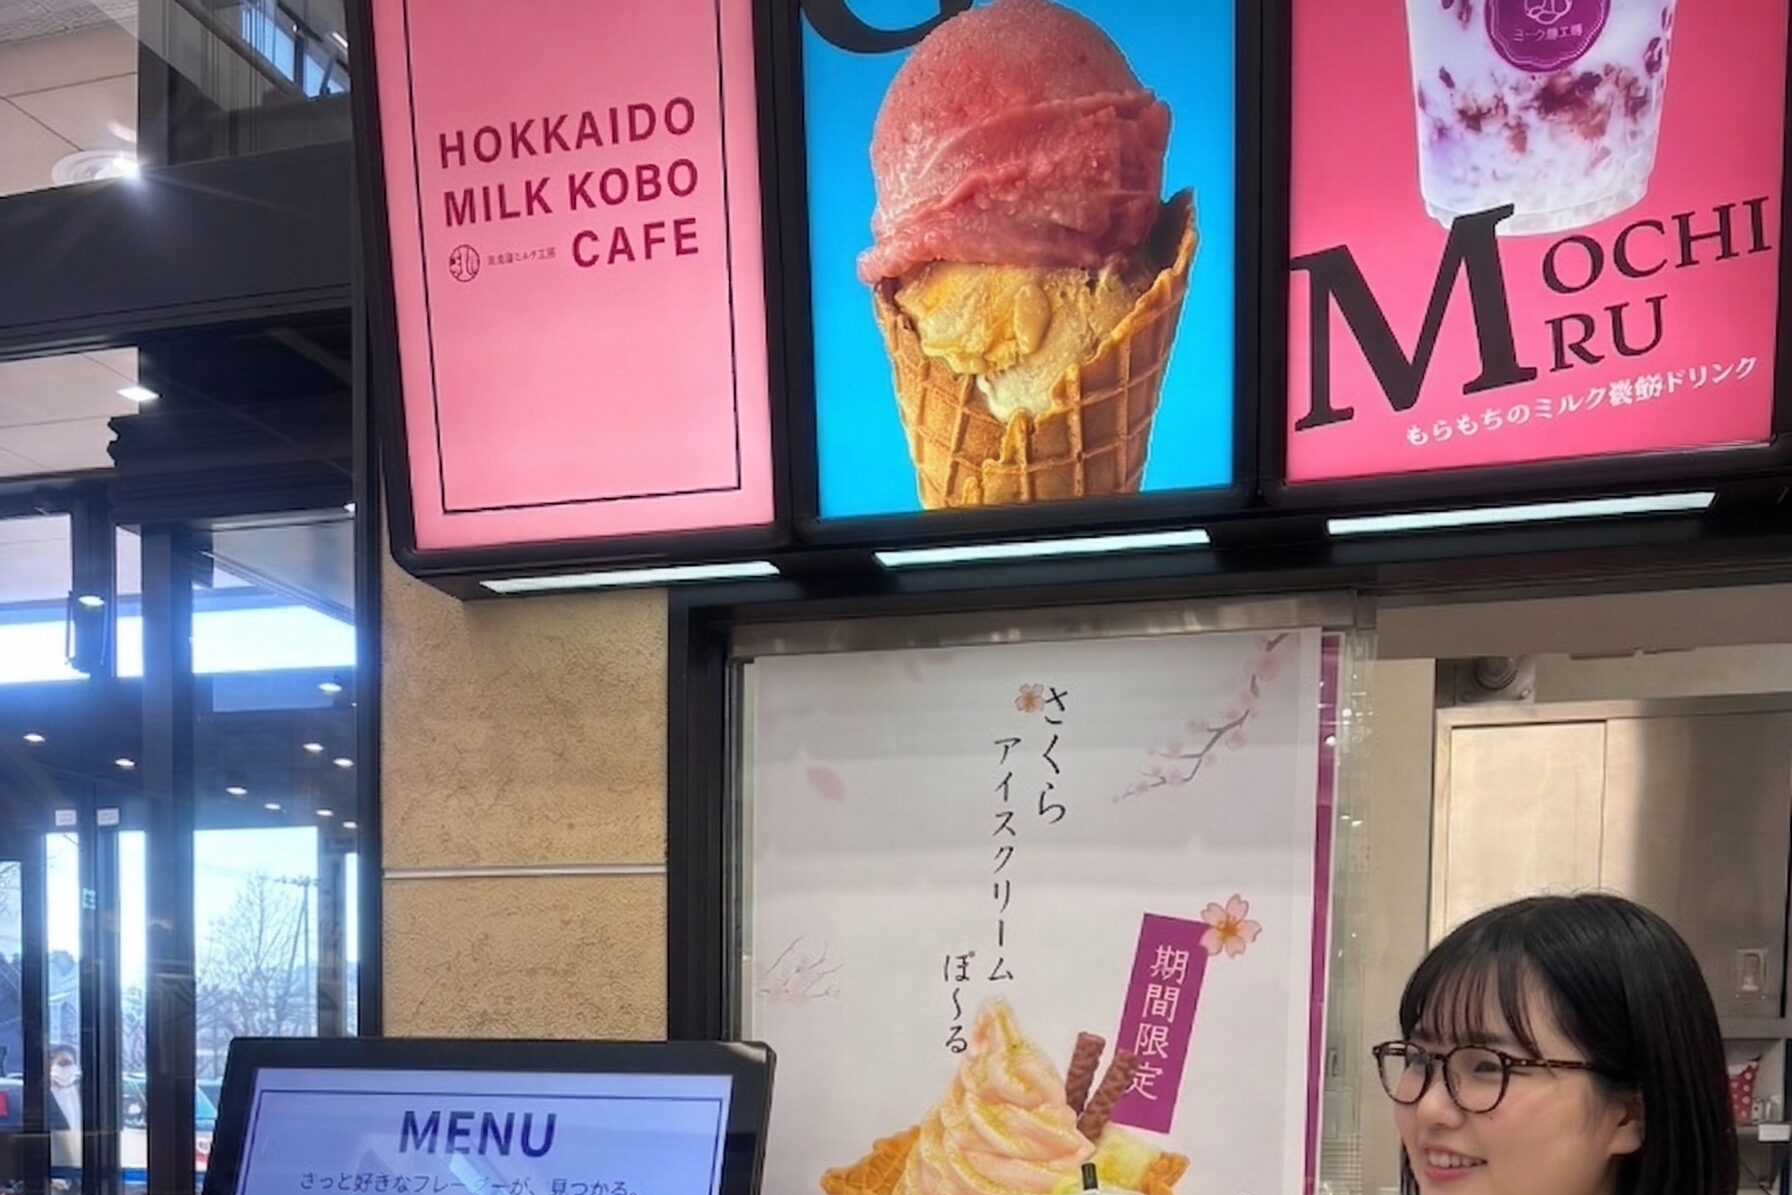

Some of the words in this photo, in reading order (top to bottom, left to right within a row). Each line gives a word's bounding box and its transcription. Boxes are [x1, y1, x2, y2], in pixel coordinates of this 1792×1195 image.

[438, 97, 696, 169] HOKKAIDO
[444, 177, 553, 227] MILK
[567, 158, 699, 212] KOBO
[572, 217, 699, 268] CAFE
[1545, 295, 1669, 373] RU
[1038, 686, 1068, 824] さくら
[988, 736, 1022, 981] アイスクリーム
[1125, 945, 1190, 1100] 期間限定
[399, 1110, 557, 1158] MENU
